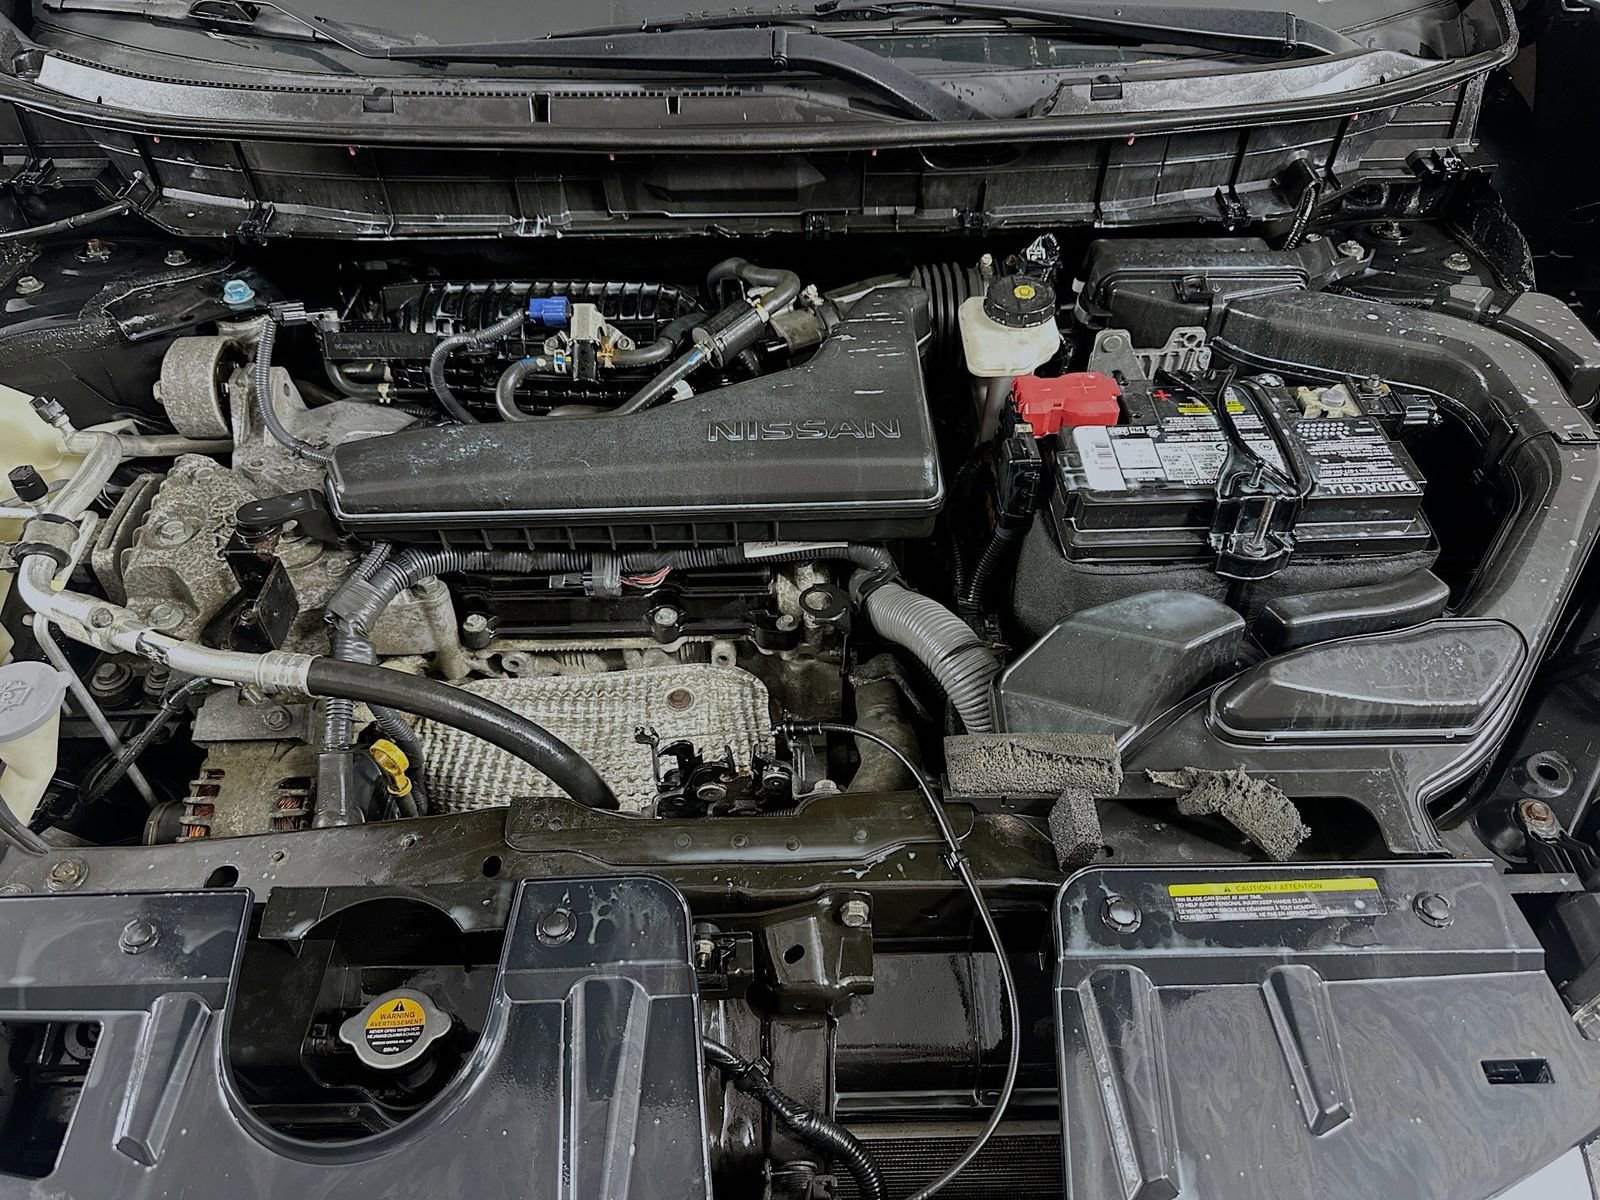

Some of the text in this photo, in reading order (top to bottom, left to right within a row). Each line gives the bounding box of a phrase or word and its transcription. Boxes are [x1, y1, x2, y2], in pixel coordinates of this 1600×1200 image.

[708, 419, 900, 442] NISSAN
[1323, 481, 1417, 494] DURACELL
[1236, 884, 1272, 892] CAUTION
[1280, 882, 1323, 890] ATTENTION
[380, 1012, 415, 1020] WARNING
[370, 1018, 423, 1027] AVERTISSEMENT
